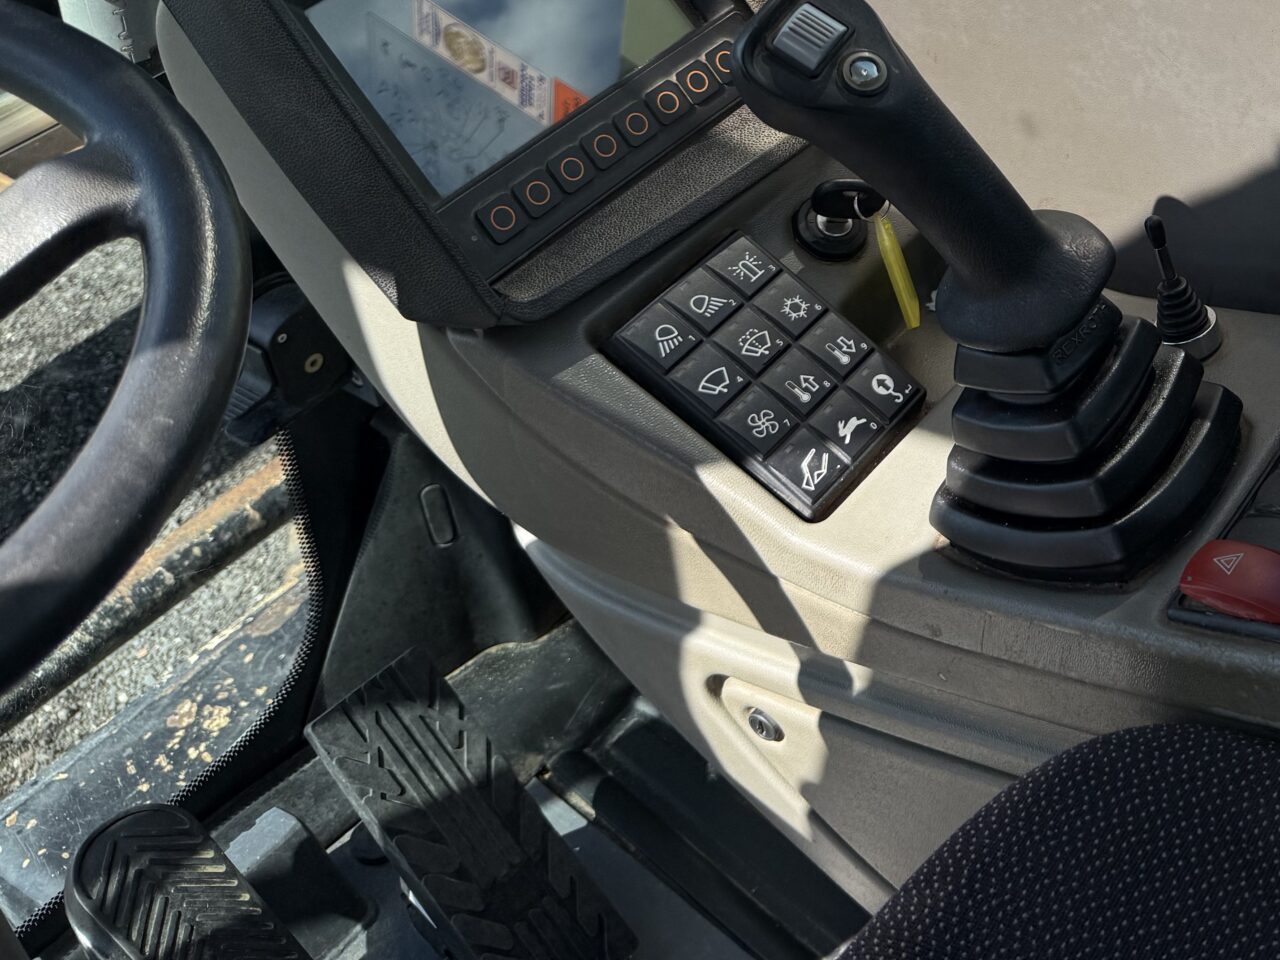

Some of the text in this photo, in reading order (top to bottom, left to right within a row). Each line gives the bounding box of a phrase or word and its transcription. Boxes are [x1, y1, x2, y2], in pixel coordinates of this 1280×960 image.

[814, 303, 822, 311] 6
[860, 342, 868, 350] 9
[736, 375, 744, 383] 4
[823, 380, 831, 388] 8
[783, 418, 791, 427] 7
